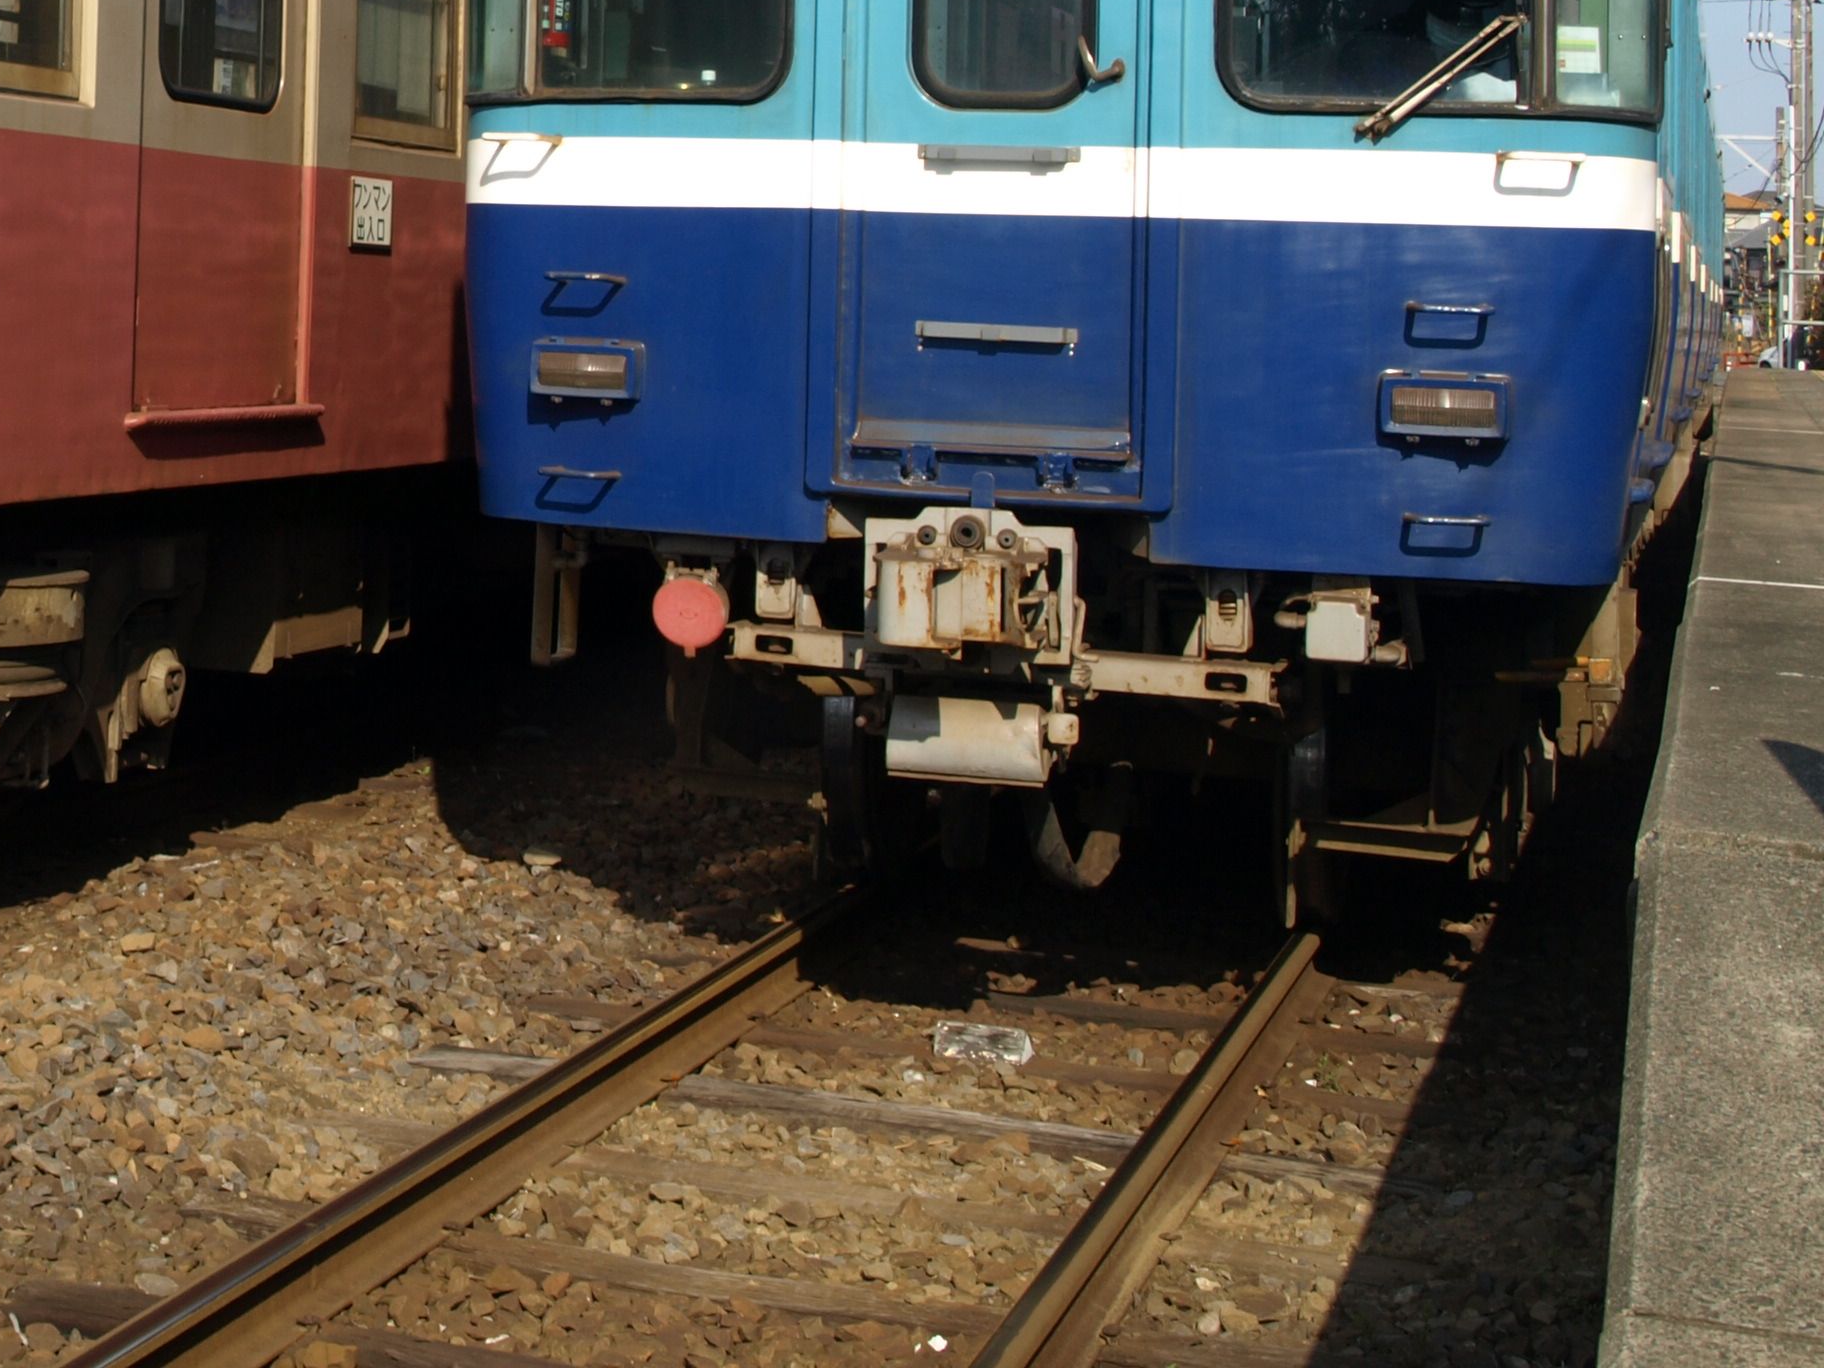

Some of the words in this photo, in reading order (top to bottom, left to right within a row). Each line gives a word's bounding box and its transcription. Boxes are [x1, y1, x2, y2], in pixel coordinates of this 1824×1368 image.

[353, 182, 391, 212] ワンマン
[356, 215, 385, 241] 出入口
